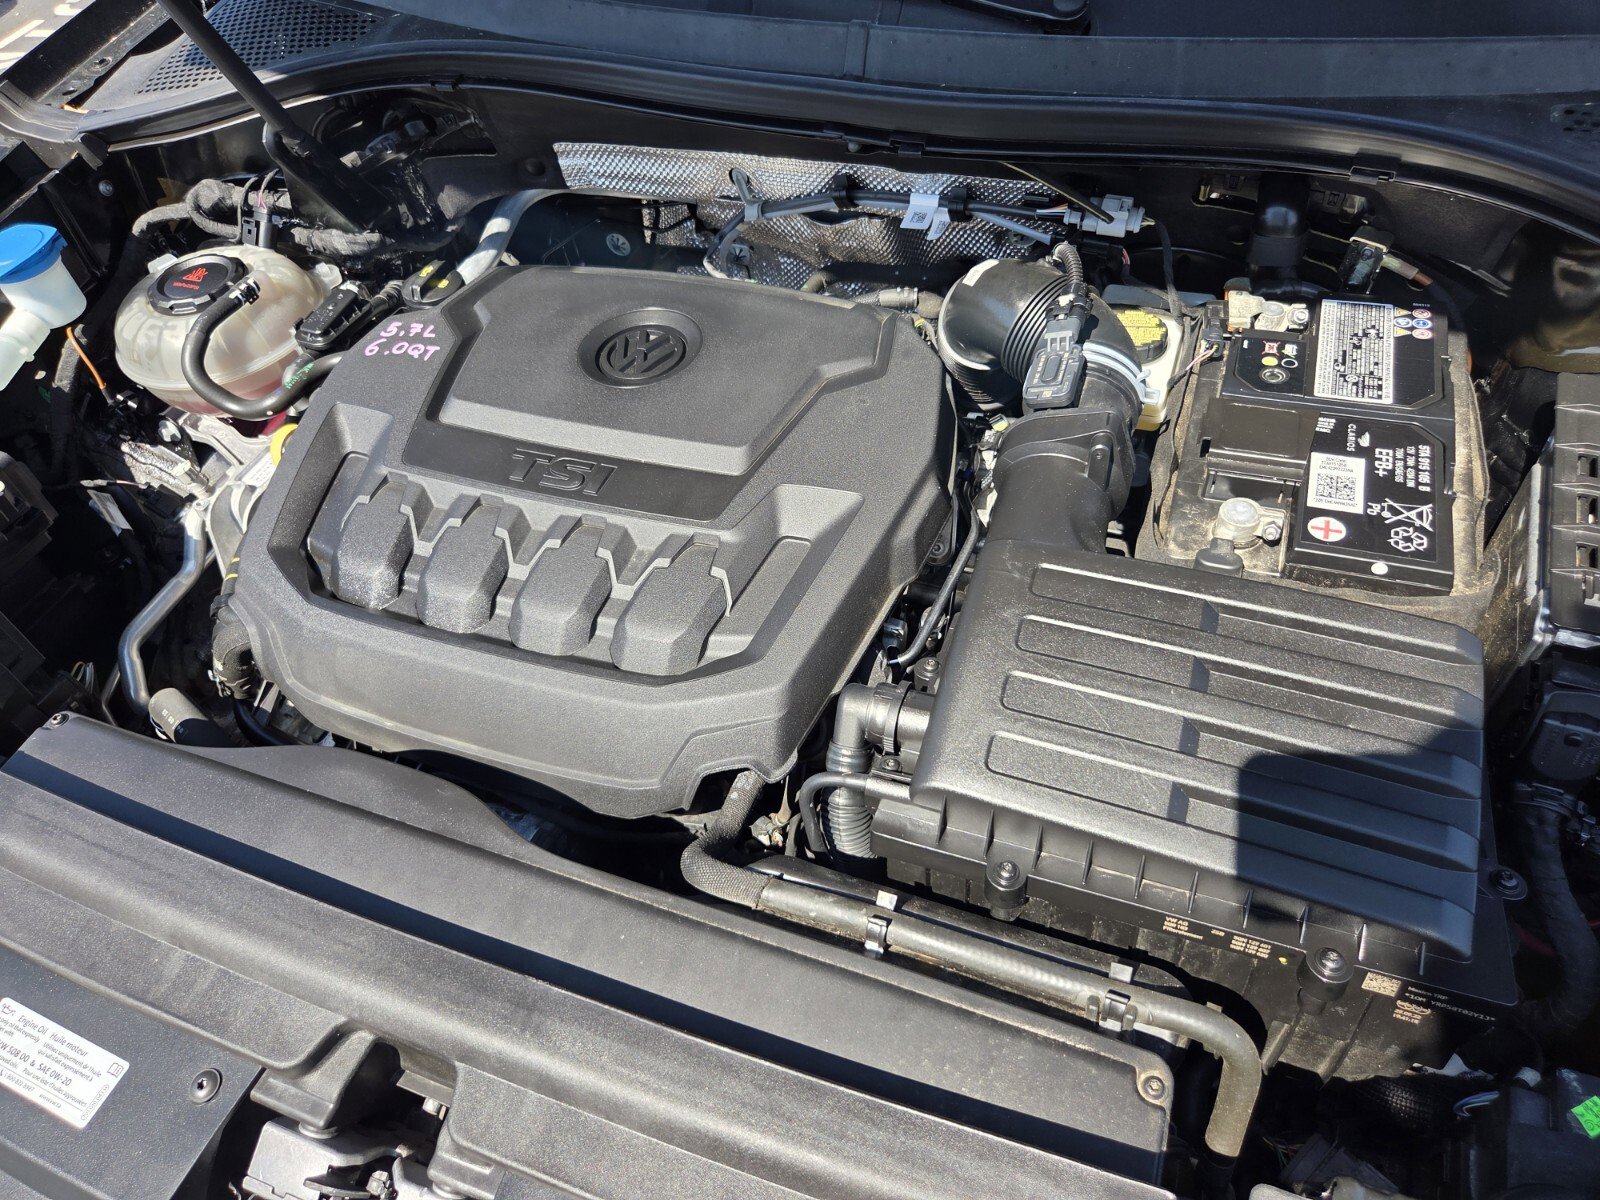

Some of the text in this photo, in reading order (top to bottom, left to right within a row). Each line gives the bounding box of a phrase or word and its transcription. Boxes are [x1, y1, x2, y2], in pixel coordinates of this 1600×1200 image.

[364, 338, 441, 361] 6.0QT
[1346, 423, 1357, 452] CLARIOS
[508, 448, 618, 497] TSI
[1374, 448, 1394, 477] EFB+
[1367, 502, 1381, 515] Pb
[18, 1015, 49, 1035] Engine Oil
[50, 1033, 88, 1057] Huile moteur
[7, 1046, 22, 1058] 508
[20, 1052, 31, 1063] 00
[37, 1062, 52, 1075] SAE
[49, 1070, 72, 1087] 0W-20
